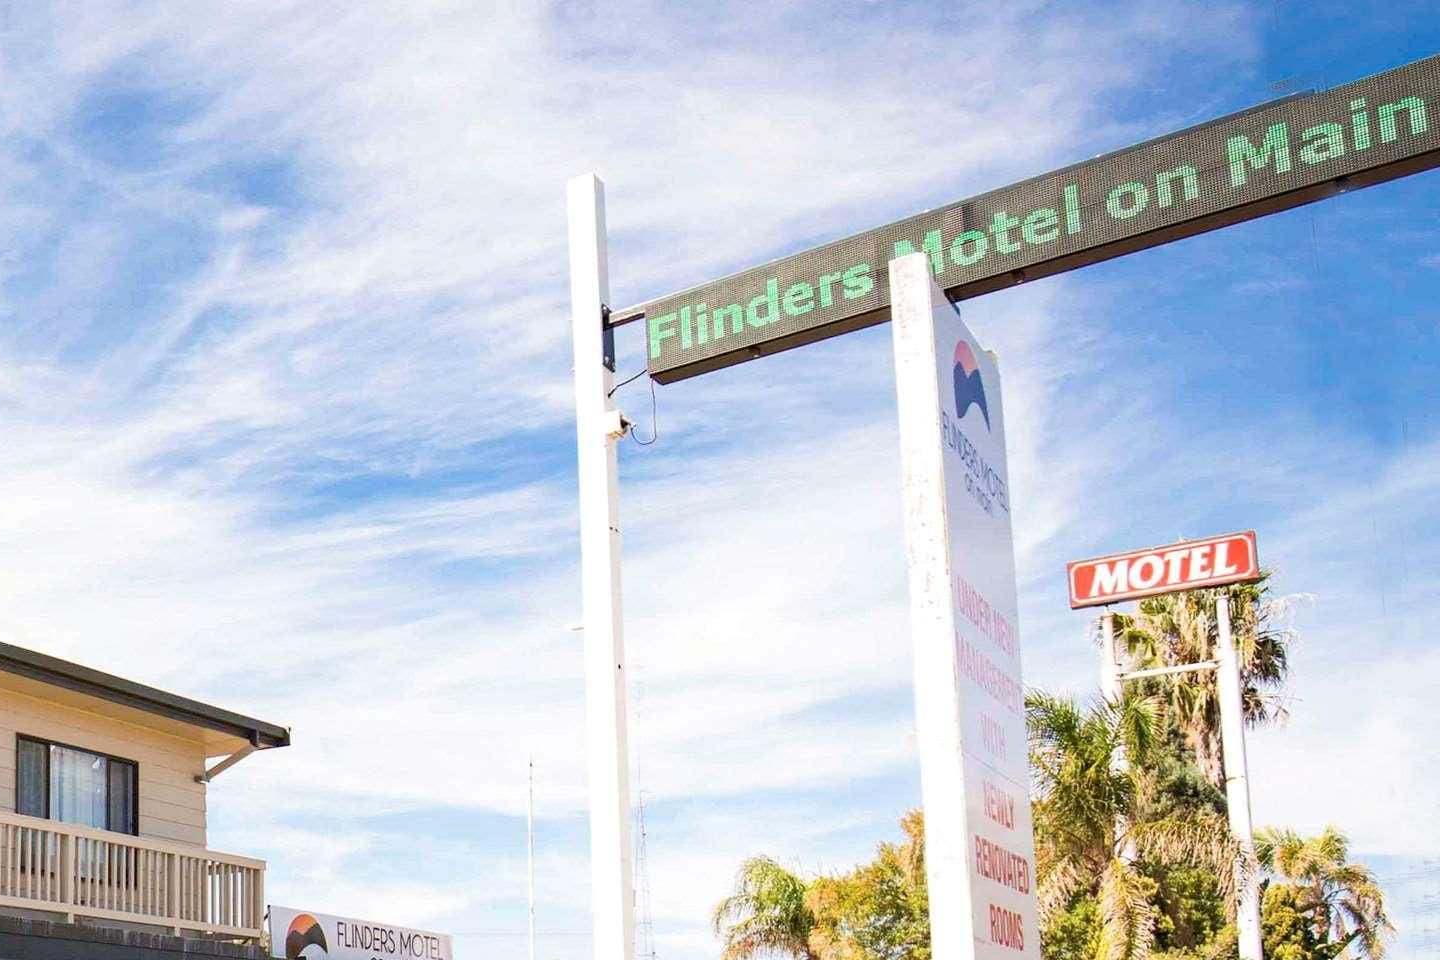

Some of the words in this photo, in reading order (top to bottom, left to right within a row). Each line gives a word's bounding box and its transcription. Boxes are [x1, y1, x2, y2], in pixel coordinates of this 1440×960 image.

[648, 261, 874, 359] Flinders
[893, 183, 1081, 275] Motel
[1106, 165, 1199, 220] on
[1225, 96, 1428, 188] Main
[1088, 543, 1238, 597] MOTEL
[982, 779, 1015, 830] NEWLY
[974, 834, 1030, 895] RENOVATED
[336, 921, 396, 954] FLINDERS
[399, 931, 444, 960] MOTEL
[989, 903, 1025, 951] ROOMS
